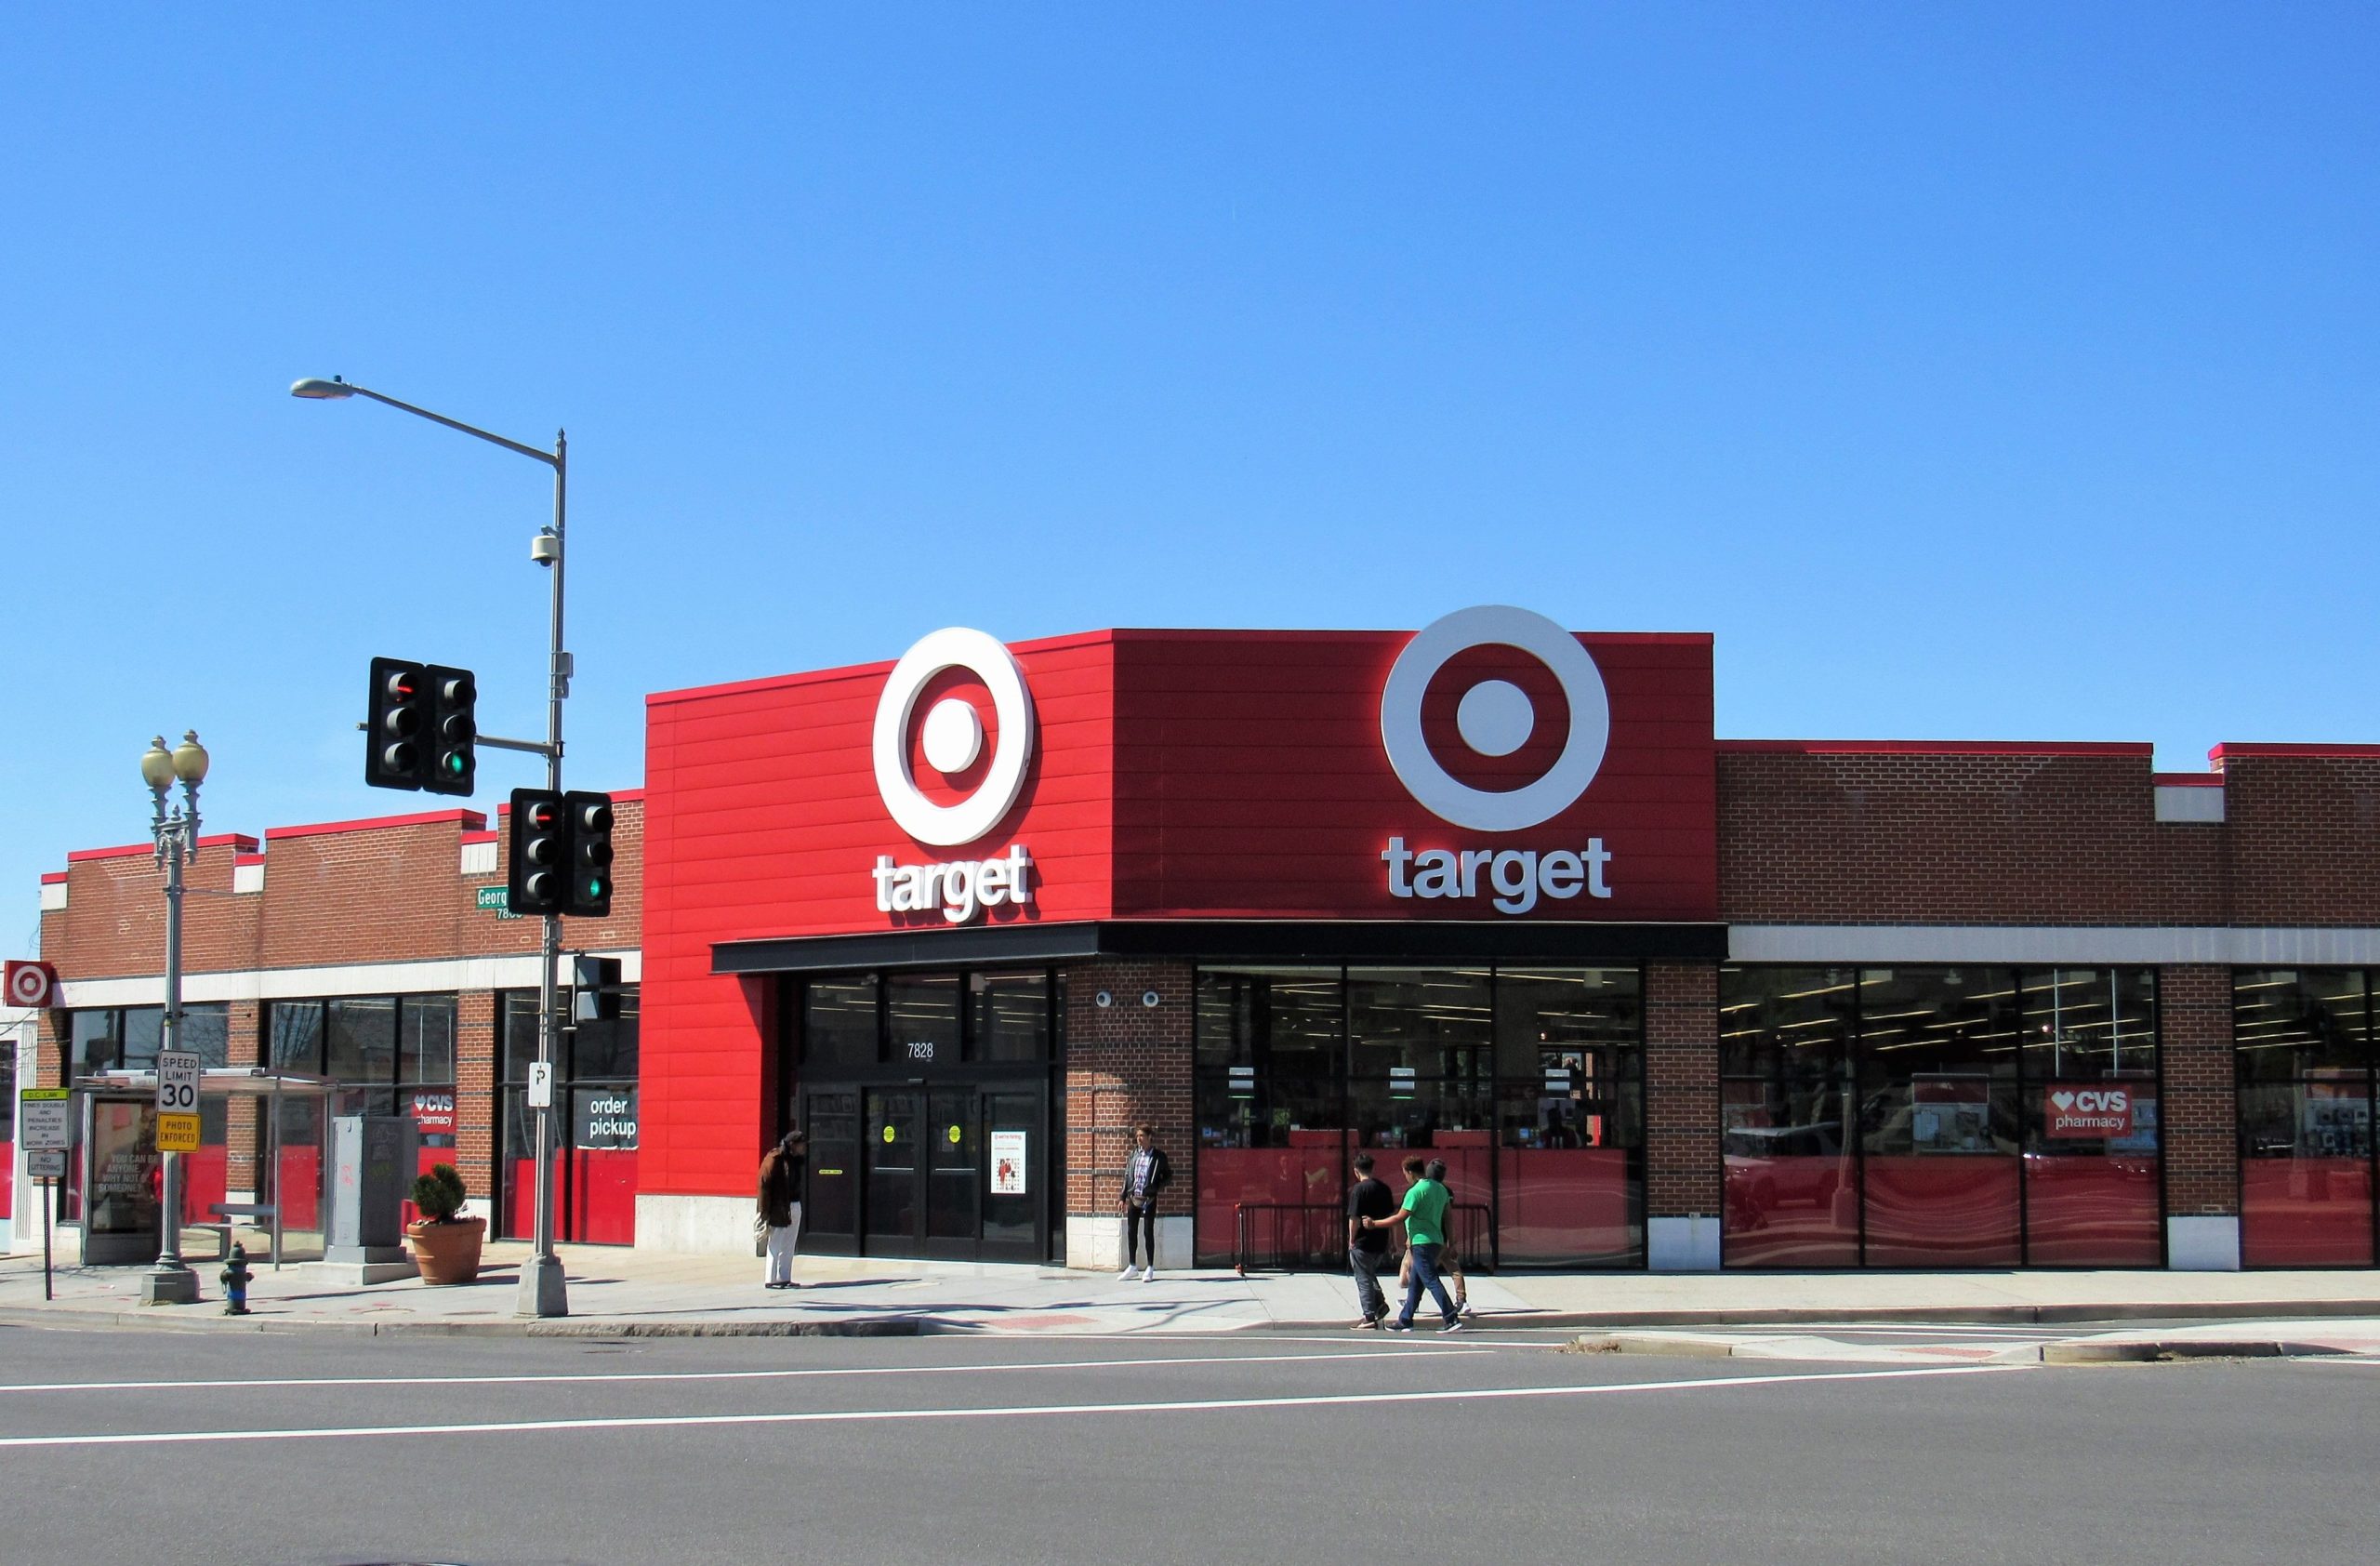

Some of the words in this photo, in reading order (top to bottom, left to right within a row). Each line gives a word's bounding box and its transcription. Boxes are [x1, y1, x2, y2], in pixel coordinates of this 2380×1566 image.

[872, 844, 1033, 923] target
[1382, 837, 1611, 915] target
[478, 889, 507, 906] Georg
[907, 1042, 933, 1058] 7828
[162, 1057, 197, 1068] SPEED
[165, 1070, 192, 1081] LIMIT
[162, 1084, 194, 1108] 30
[426, 1095, 454, 1112] CVS
[2076, 1091, 2127, 1112] CVS
[590, 1096, 628, 1114] order
[165, 1121, 192, 1130] PHOTO
[589, 1118, 637, 1139] pickup
[2055, 1114, 2125, 1131] pharmacy
[160, 1132, 195, 1143] ENFORCED
[112, 1154, 127, 1162] YOU
[129, 1154, 146, 1162] CAN
[102, 1174, 121, 1182] WHY
[123, 1174, 139, 1182] NOT
